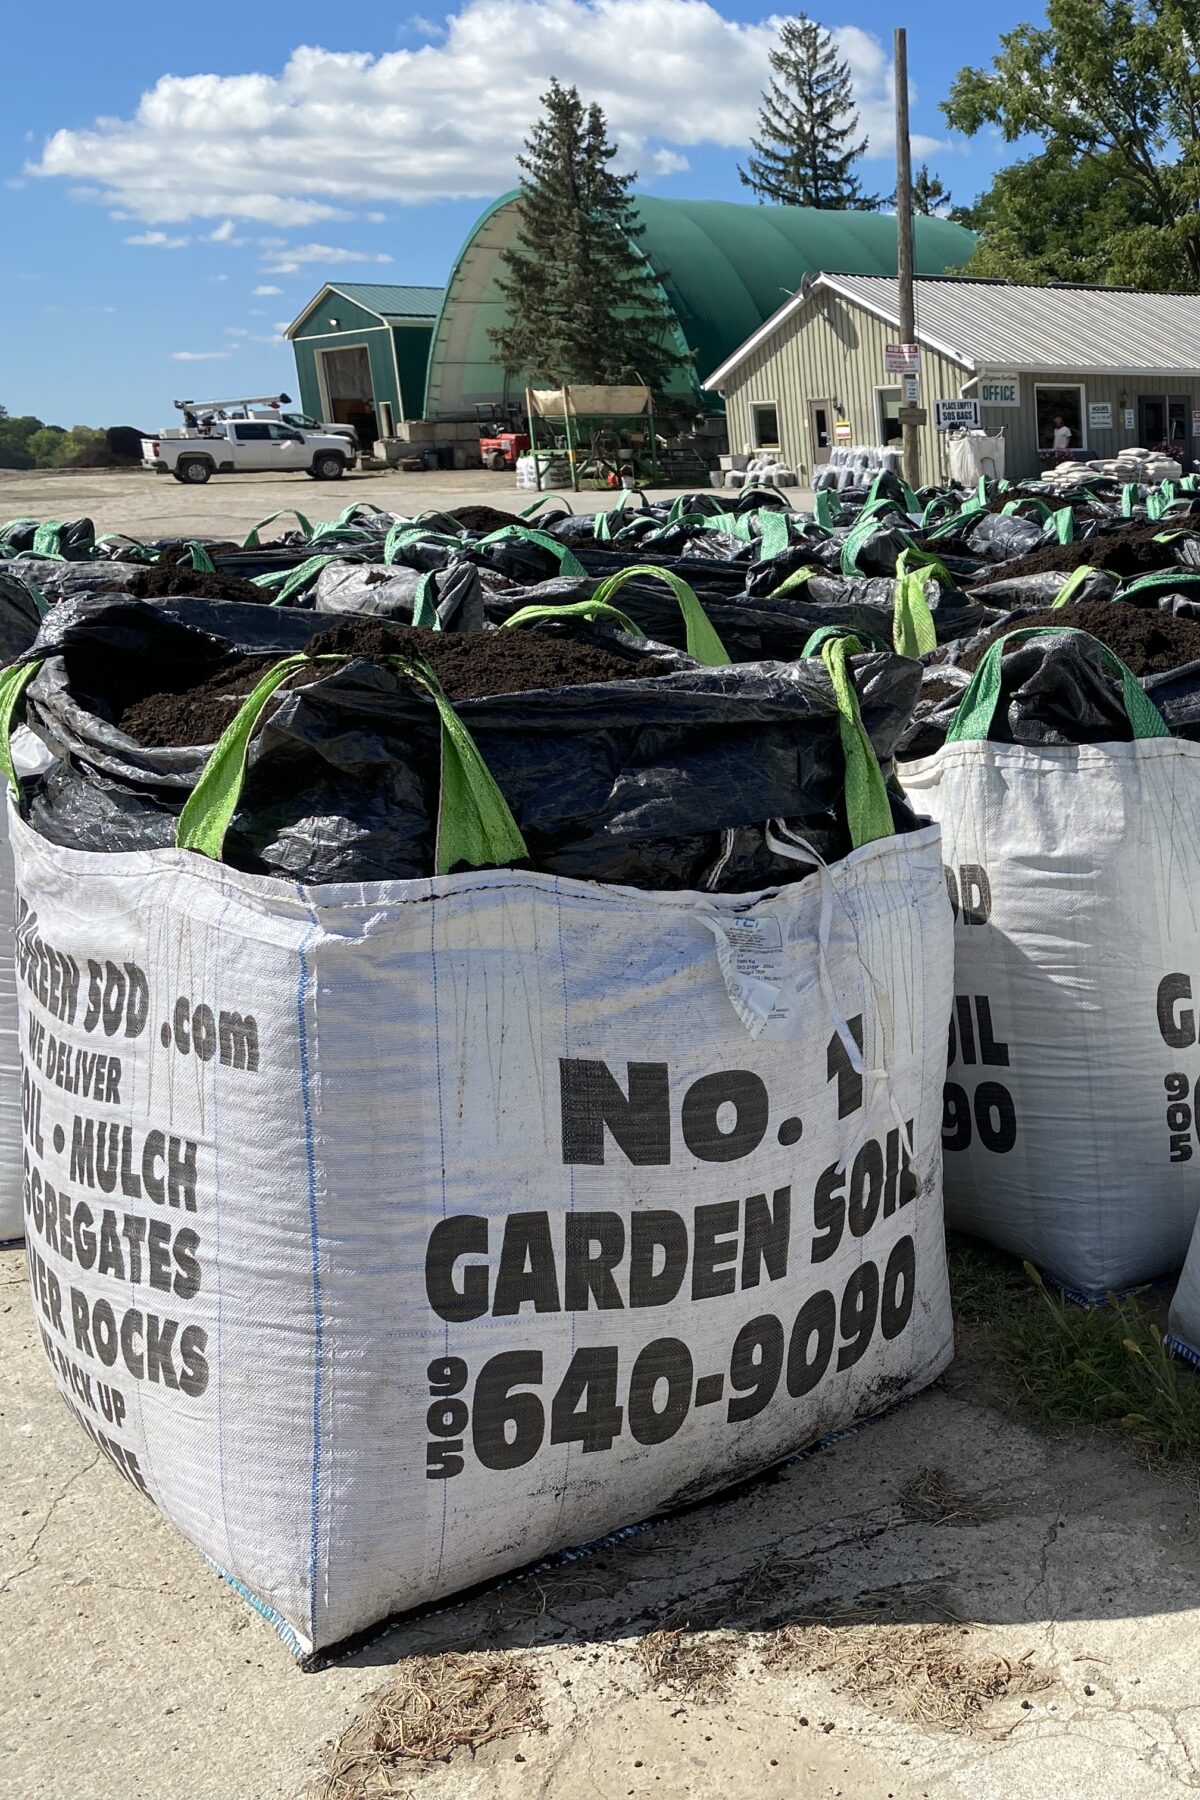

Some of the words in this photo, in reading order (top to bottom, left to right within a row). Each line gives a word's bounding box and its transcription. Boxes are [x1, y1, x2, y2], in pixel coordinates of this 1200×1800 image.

[942, 401, 957, 411] PLACE
[957, 401, 972, 410] EMPTY
[942, 411, 956, 421] SOS
[956, 410, 973, 421] BAGS
[982, 385, 1015, 401] OFFICE
[28, 1009, 45, 1069] WE
[46, 1039, 122, 1105] DELIVER
[83, 958, 150, 1039] SOD
[160, 995, 260, 1073] .com
[559, 1058, 803, 1165] No.
[826, 1014, 864, 1121] 1
[941, 1081, 1017, 1154] 90
[1164, 1071, 1194, 1163] 905
[70, 1115, 198, 1213] MULCH
[22, 1146, 202, 1300] GGREGATES
[425, 1185, 792, 1323] GARDEN
[811, 1118, 921, 1264] SOIL
[56, 1346, 98, 1414] PICK
[97, 1380, 126, 1428] UP
[70, 1285, 210, 1398] ROCKS
[426, 1356, 469, 1480] 905
[472, 1234, 917, 1470] 640-9090
